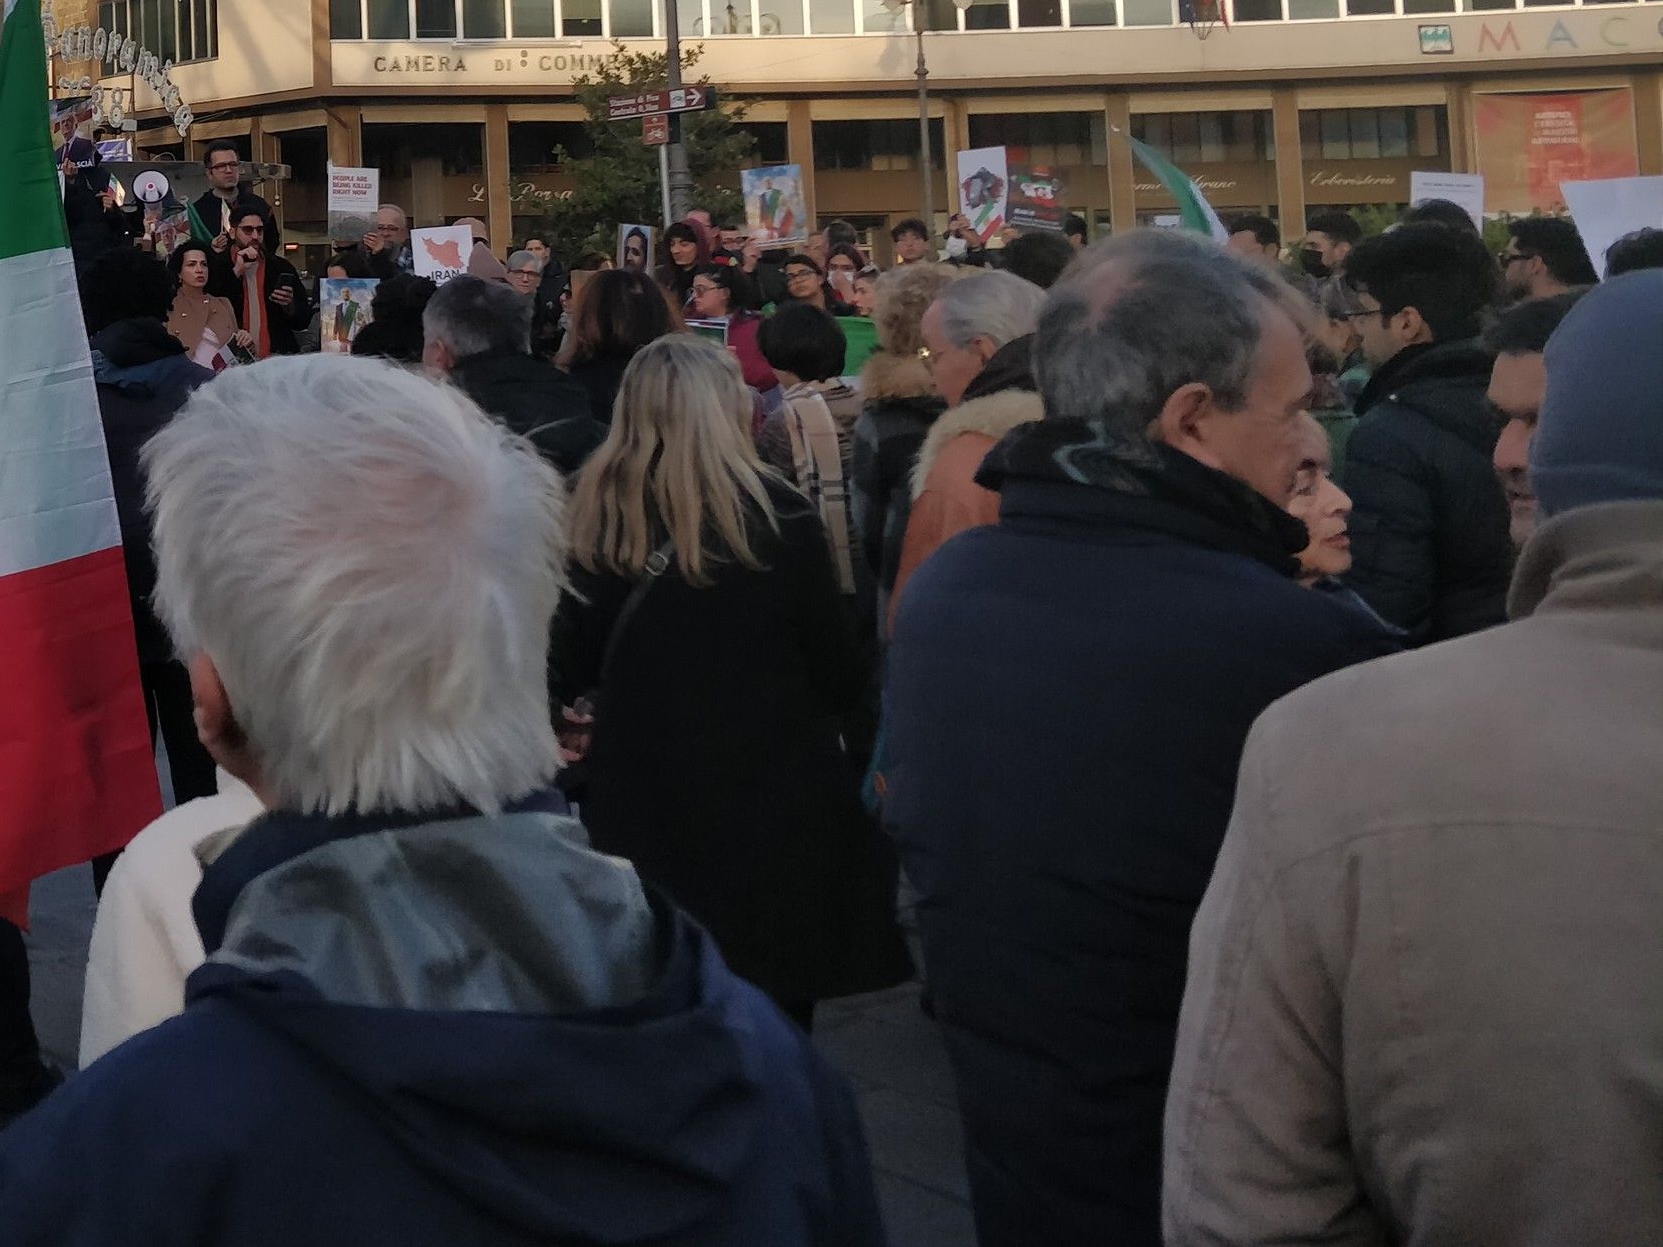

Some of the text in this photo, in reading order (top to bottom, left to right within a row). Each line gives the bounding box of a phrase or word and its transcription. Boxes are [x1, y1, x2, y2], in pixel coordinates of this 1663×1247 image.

[373, 55, 468, 72] CAMERA
[494, 59, 512, 71] DI
[431, 269, 460, 281] IRAN
